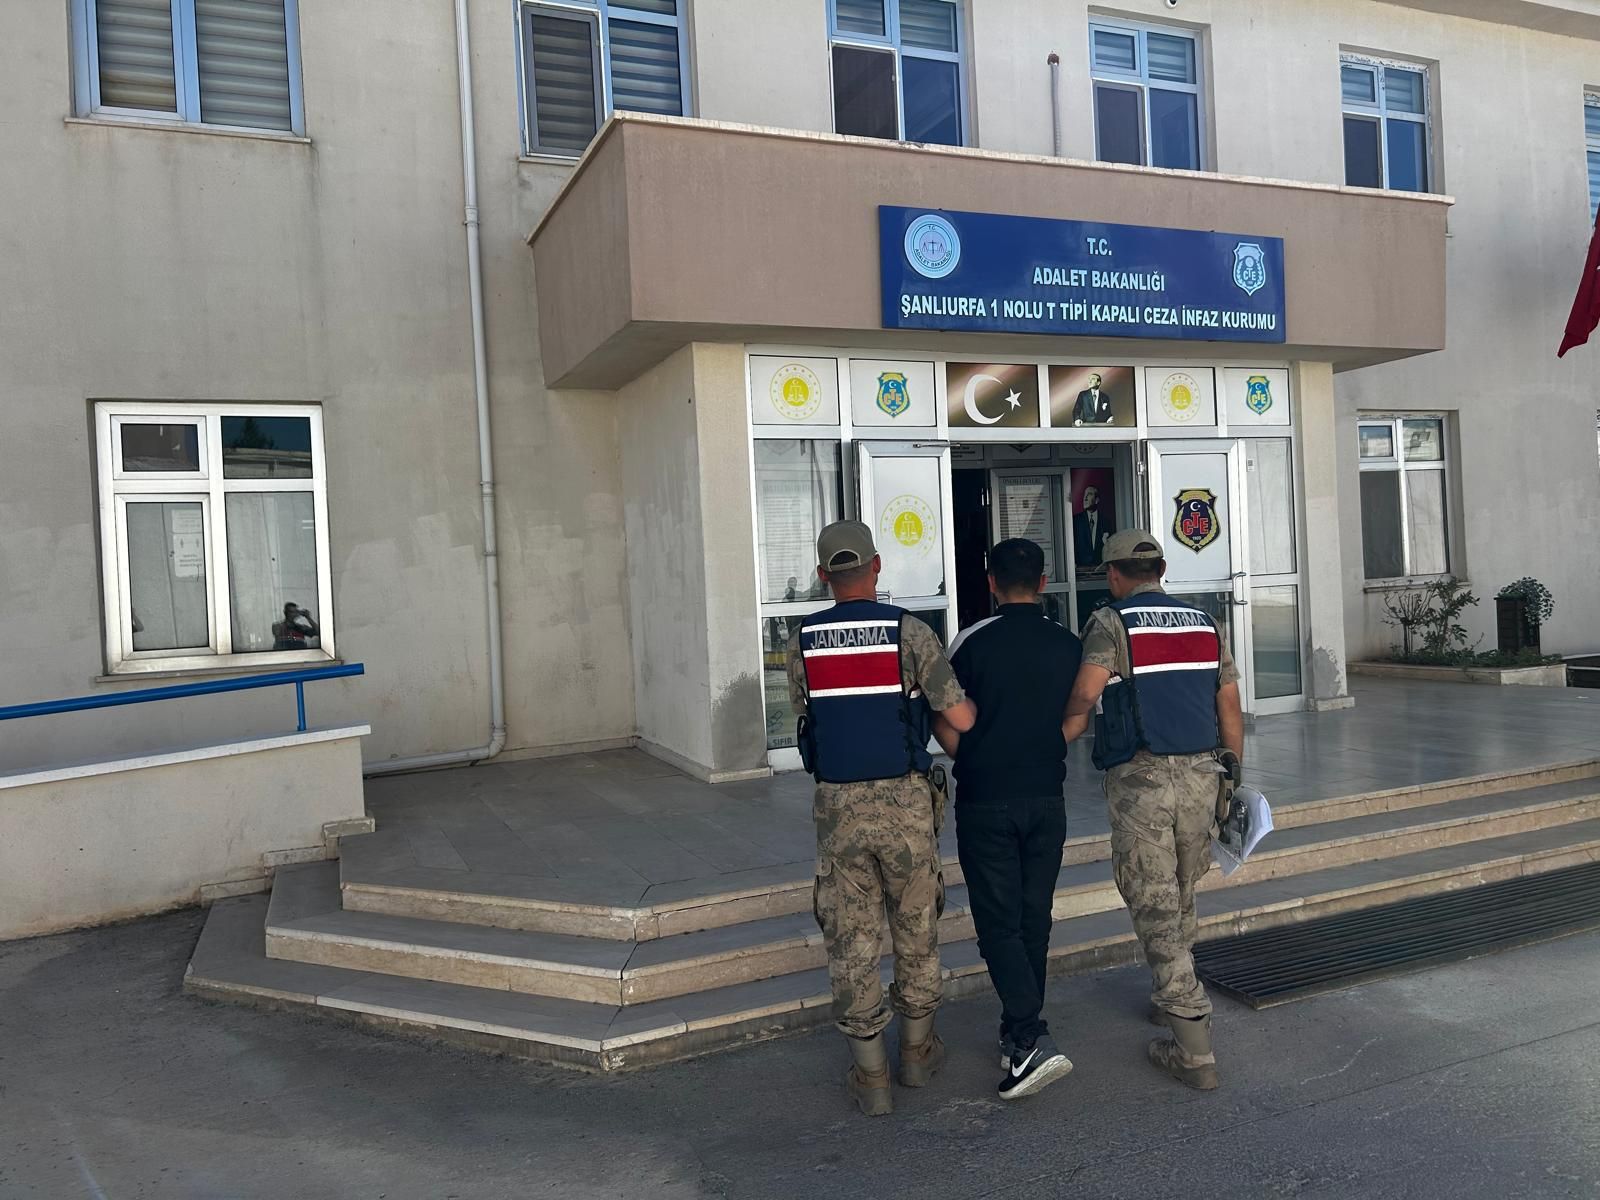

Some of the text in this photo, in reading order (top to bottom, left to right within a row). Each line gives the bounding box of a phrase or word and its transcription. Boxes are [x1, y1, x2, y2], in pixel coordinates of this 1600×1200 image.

[1086, 237, 1112, 256] T.C.
[1033, 266, 1165, 292] ADALET BAKANLIĞI
[901, 294, 1276, 331] ŞANLIURFA 1 NOLU T TİPİ KAPALI CEZA İNFAZ KURUMU
[1135, 611, 1209, 627] JANDARMA
[810, 626, 890, 650] JANDARMA
